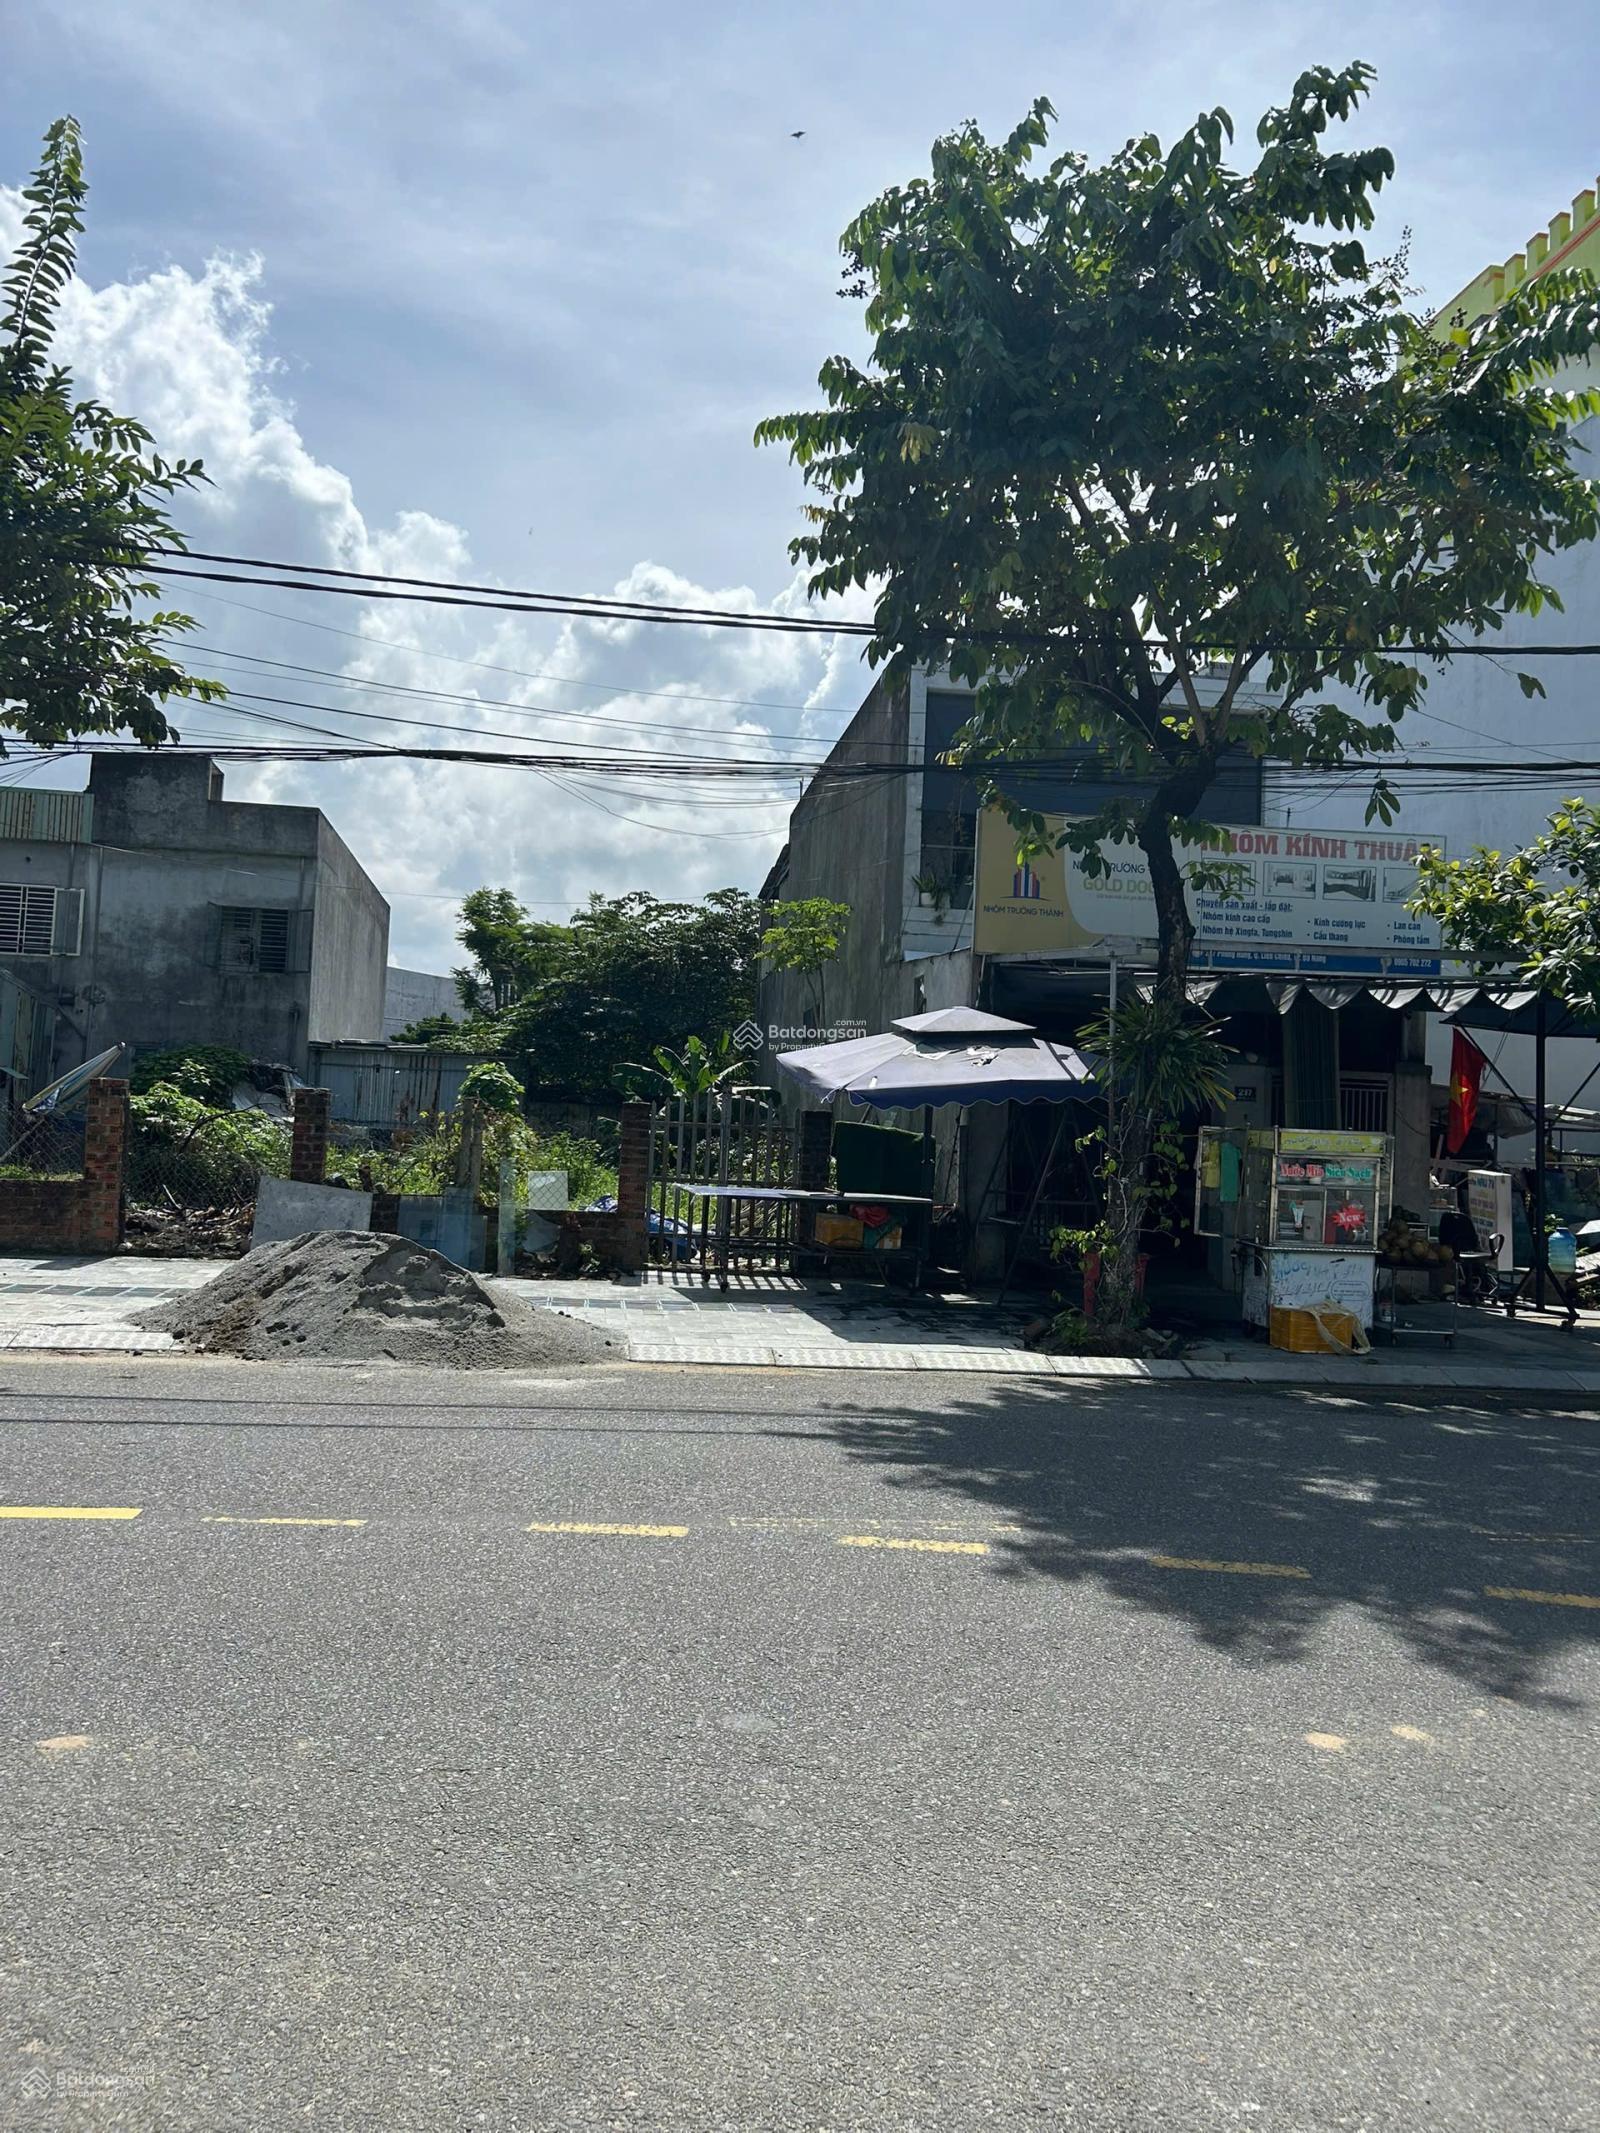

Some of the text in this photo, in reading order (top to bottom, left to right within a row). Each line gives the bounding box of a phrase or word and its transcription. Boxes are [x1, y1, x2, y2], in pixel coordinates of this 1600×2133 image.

[1285, 833, 1347, 859] KÍNH
[1083, 876, 1123, 892] GOLD
[1202, 911, 1224, 921] Nhôm
[1242, 914, 1257, 923] cao
[1313, 917, 1330, 928] Kính
[1202, 925, 1224, 935] Nhôm
[1393, 920, 1421, 931] Lan can
[1328, 932, 1349, 942] thang
[1339, 1212, 1362, 1224] New
